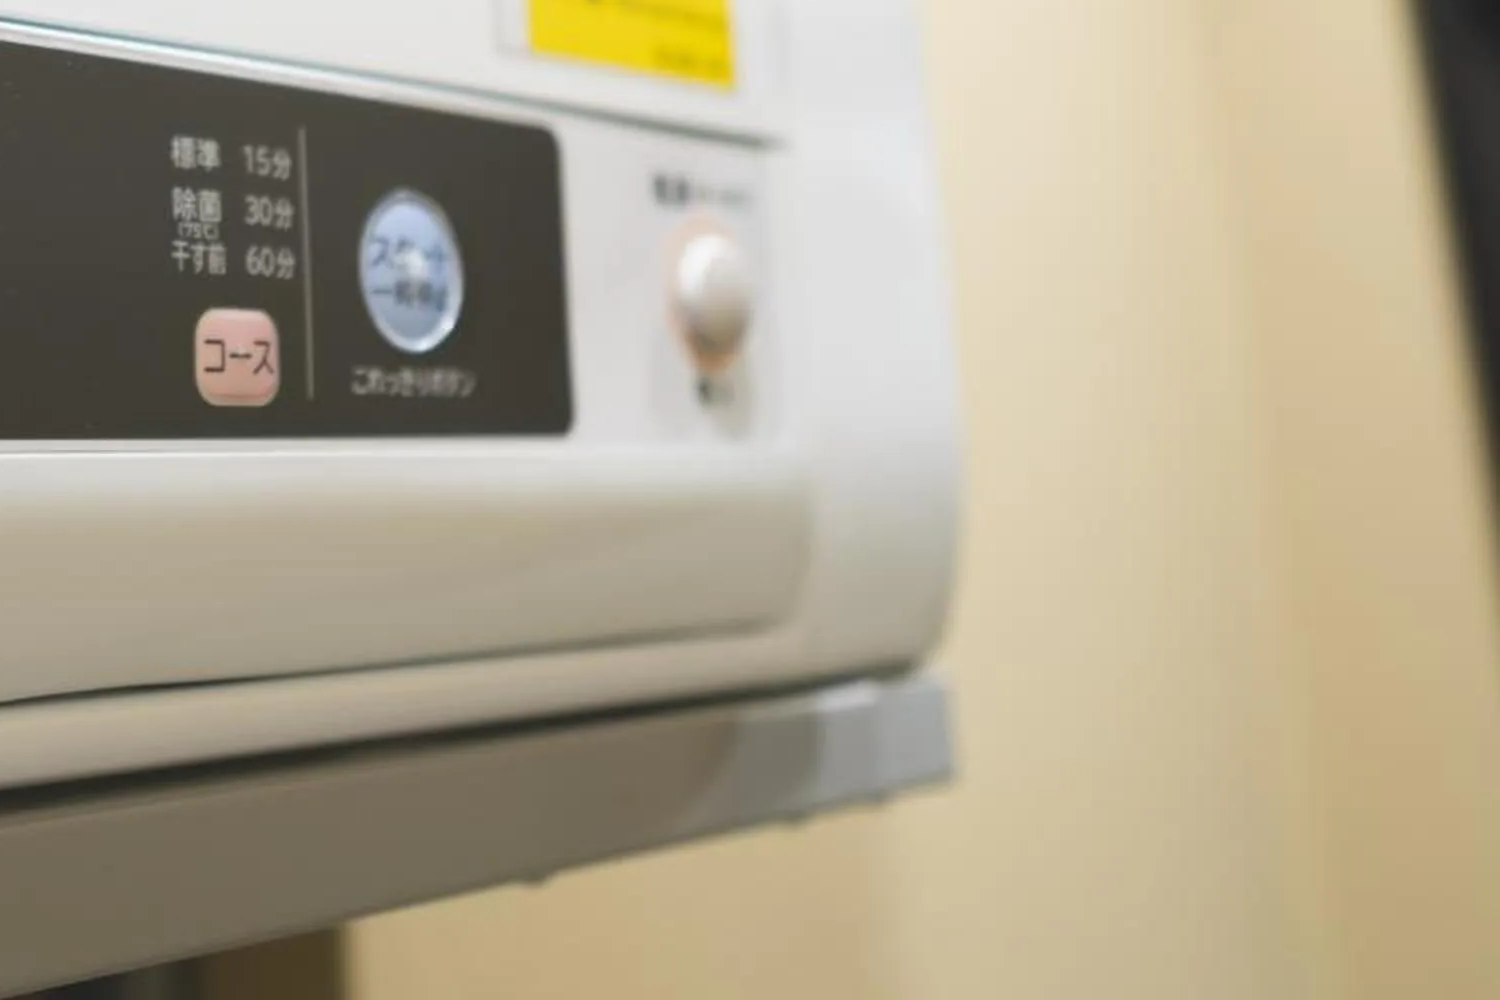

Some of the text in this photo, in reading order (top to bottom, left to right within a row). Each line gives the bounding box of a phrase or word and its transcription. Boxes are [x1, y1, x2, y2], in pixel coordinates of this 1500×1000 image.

[243, 145, 292, 182] 15分
[244, 196, 295, 232] 30分
[246, 246, 297, 281] 60分
[203, 338, 275, 376] コース
